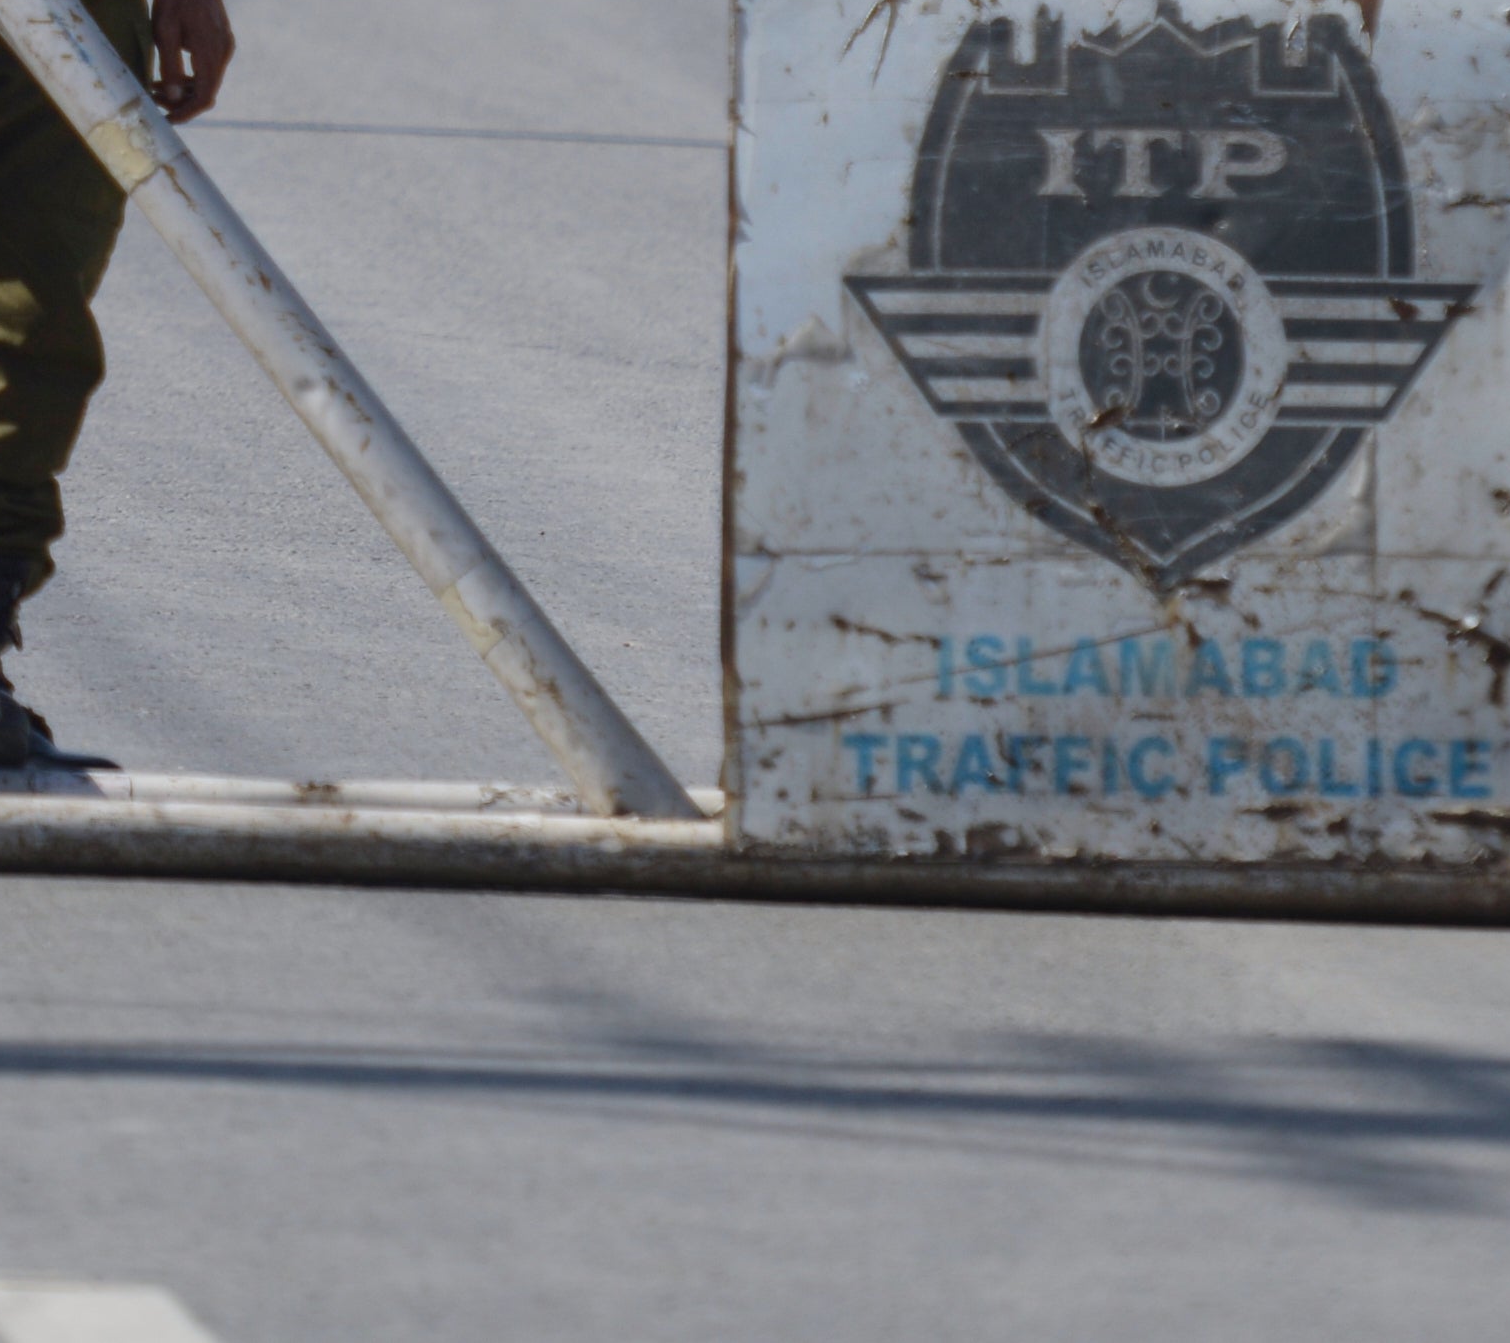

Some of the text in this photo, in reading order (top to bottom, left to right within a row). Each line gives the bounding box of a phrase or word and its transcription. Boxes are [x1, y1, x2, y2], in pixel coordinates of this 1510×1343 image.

[1036, 128, 1288, 199] ITP
[1081, 240, 1245, 291] ISLAMABAD
[1058, 387, 1270, 474] TRFFIC POLICE
[937, 635, 1399, 698] ISLAMABAD
[841, 731, 1494, 799] TRAFFIC POLICE
